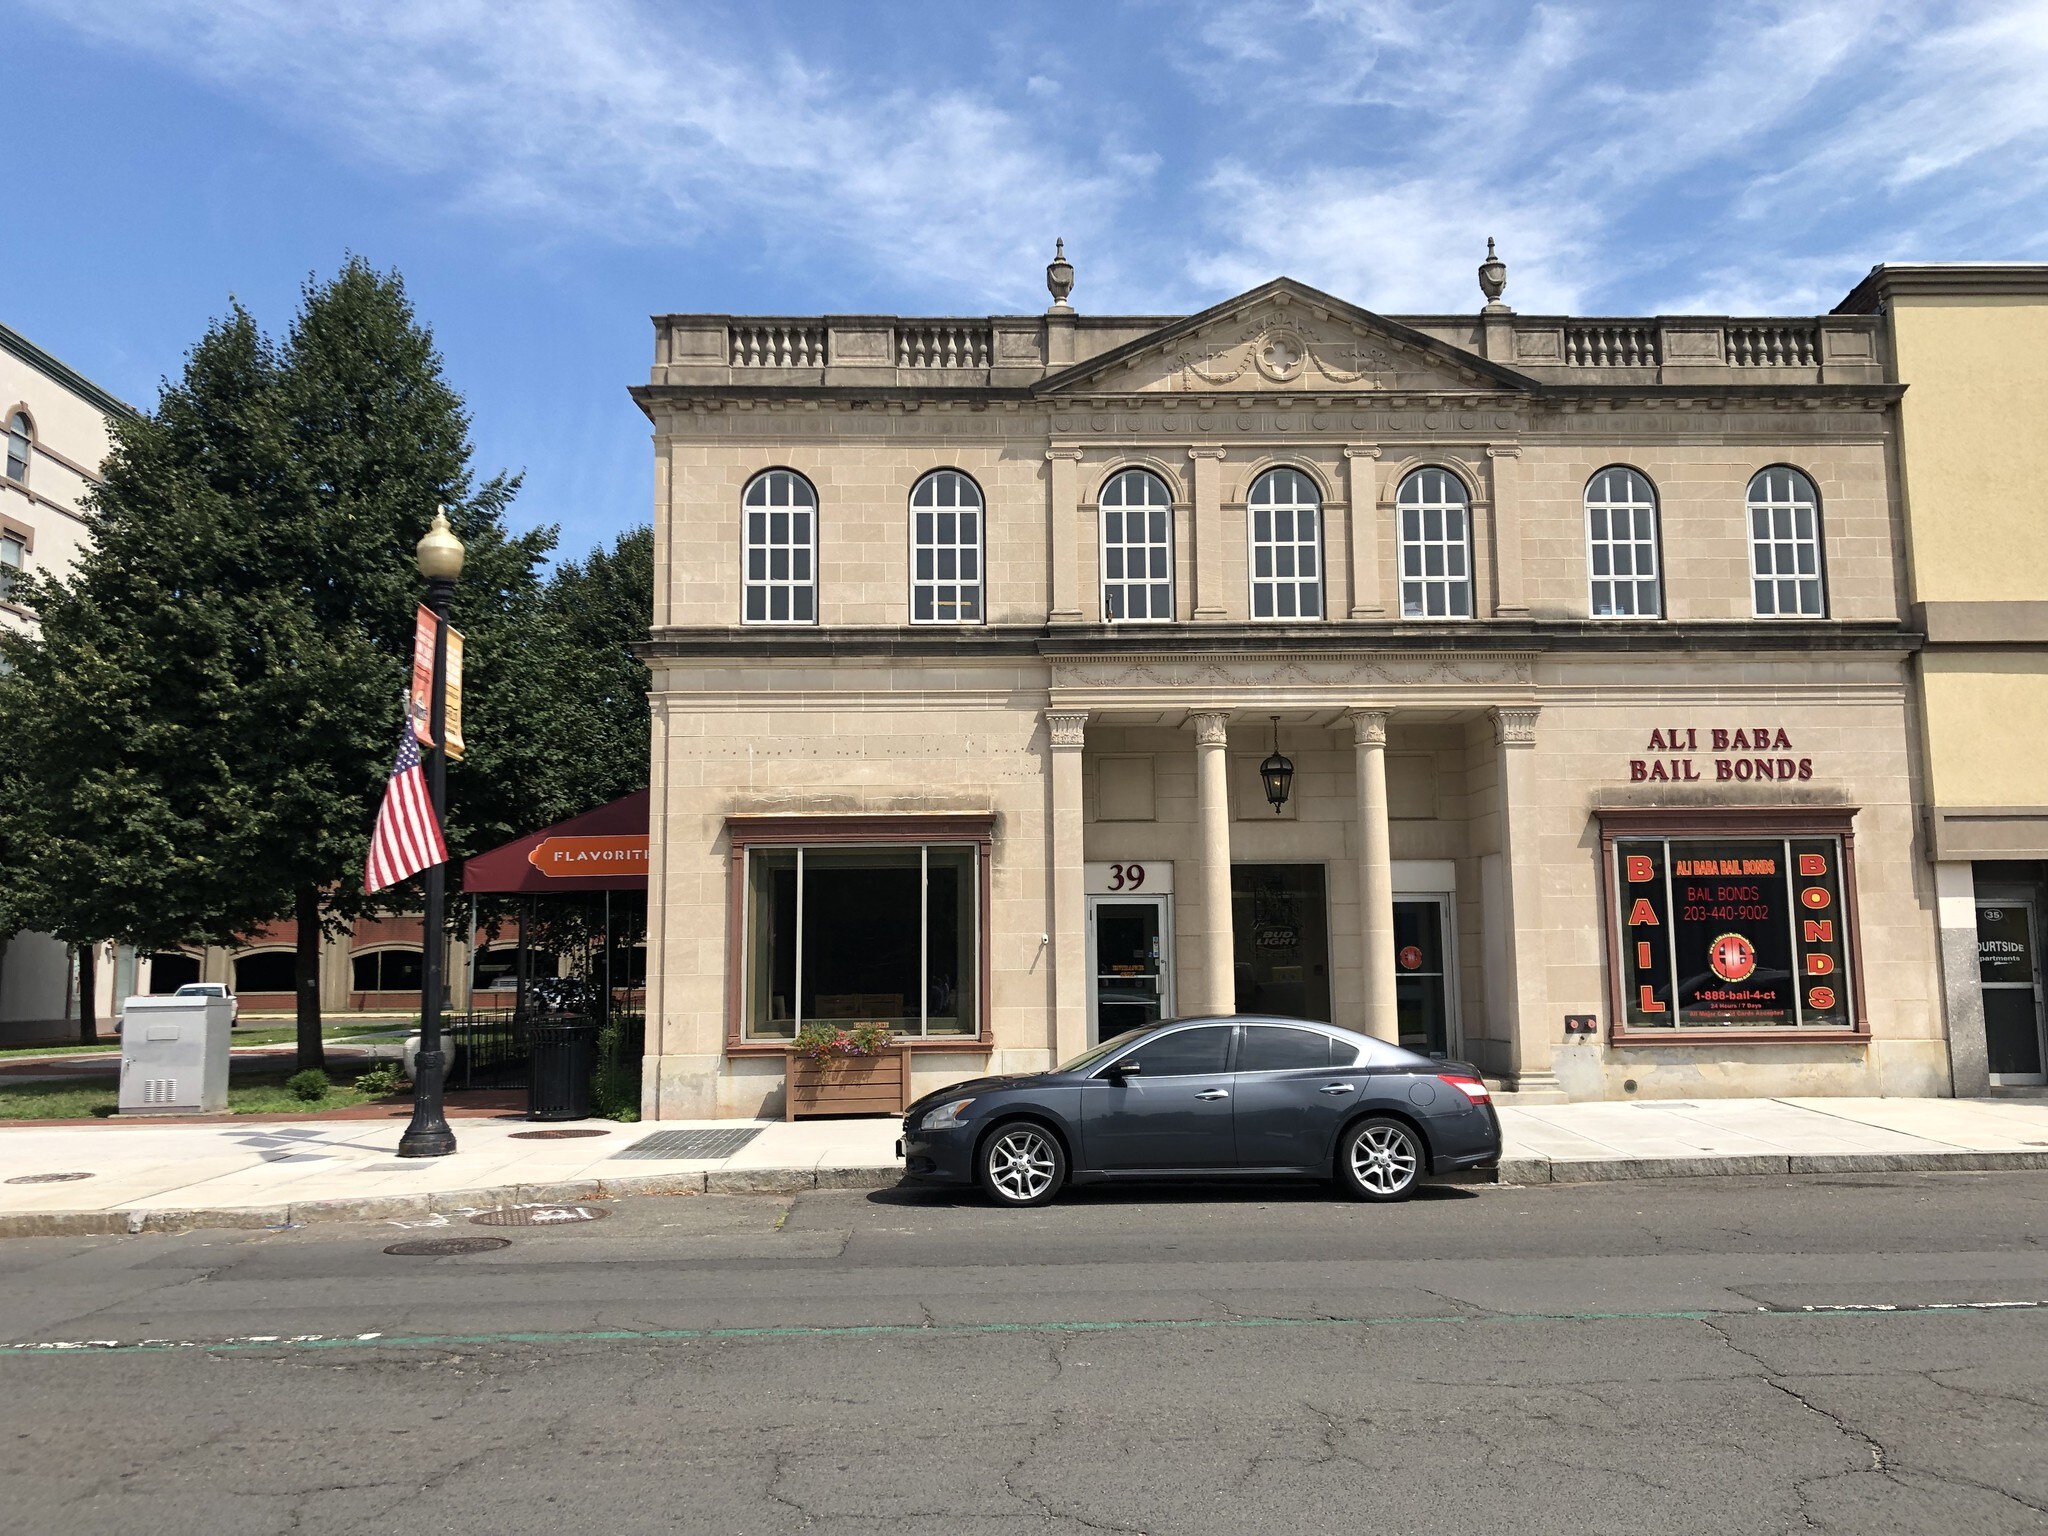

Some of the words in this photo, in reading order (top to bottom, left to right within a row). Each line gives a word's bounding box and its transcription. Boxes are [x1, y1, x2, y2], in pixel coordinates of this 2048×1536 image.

[1647, 727, 1698, 750] ALI
[1711, 727, 1793, 751] BABA
[1629, 759, 1701, 782] BAIL
[1715, 758, 1813, 782] BONDS
[1676, 860, 1692, 876] ALI
[1693, 860, 1719, 876] BABA
[1720, 860, 1742, 875] BAIL
[1742, 859, 1775, 875] BONDS
[1107, 864, 1146, 891] 39
[1687, 887, 1714, 901] BAIL
[1718, 886, 1760, 901] BONDS
[1683, 905, 1769, 921] 203-440-9002
[1987, 911, 2000, 919] 35
[1626, 855, 1666, 1013] BAIL
[1799, 853, 1836, 1010] BONDS
[1979, 955, 2021, 963] partments
[1694, 990, 1776, 1001] 1-888-bail-4-ct
